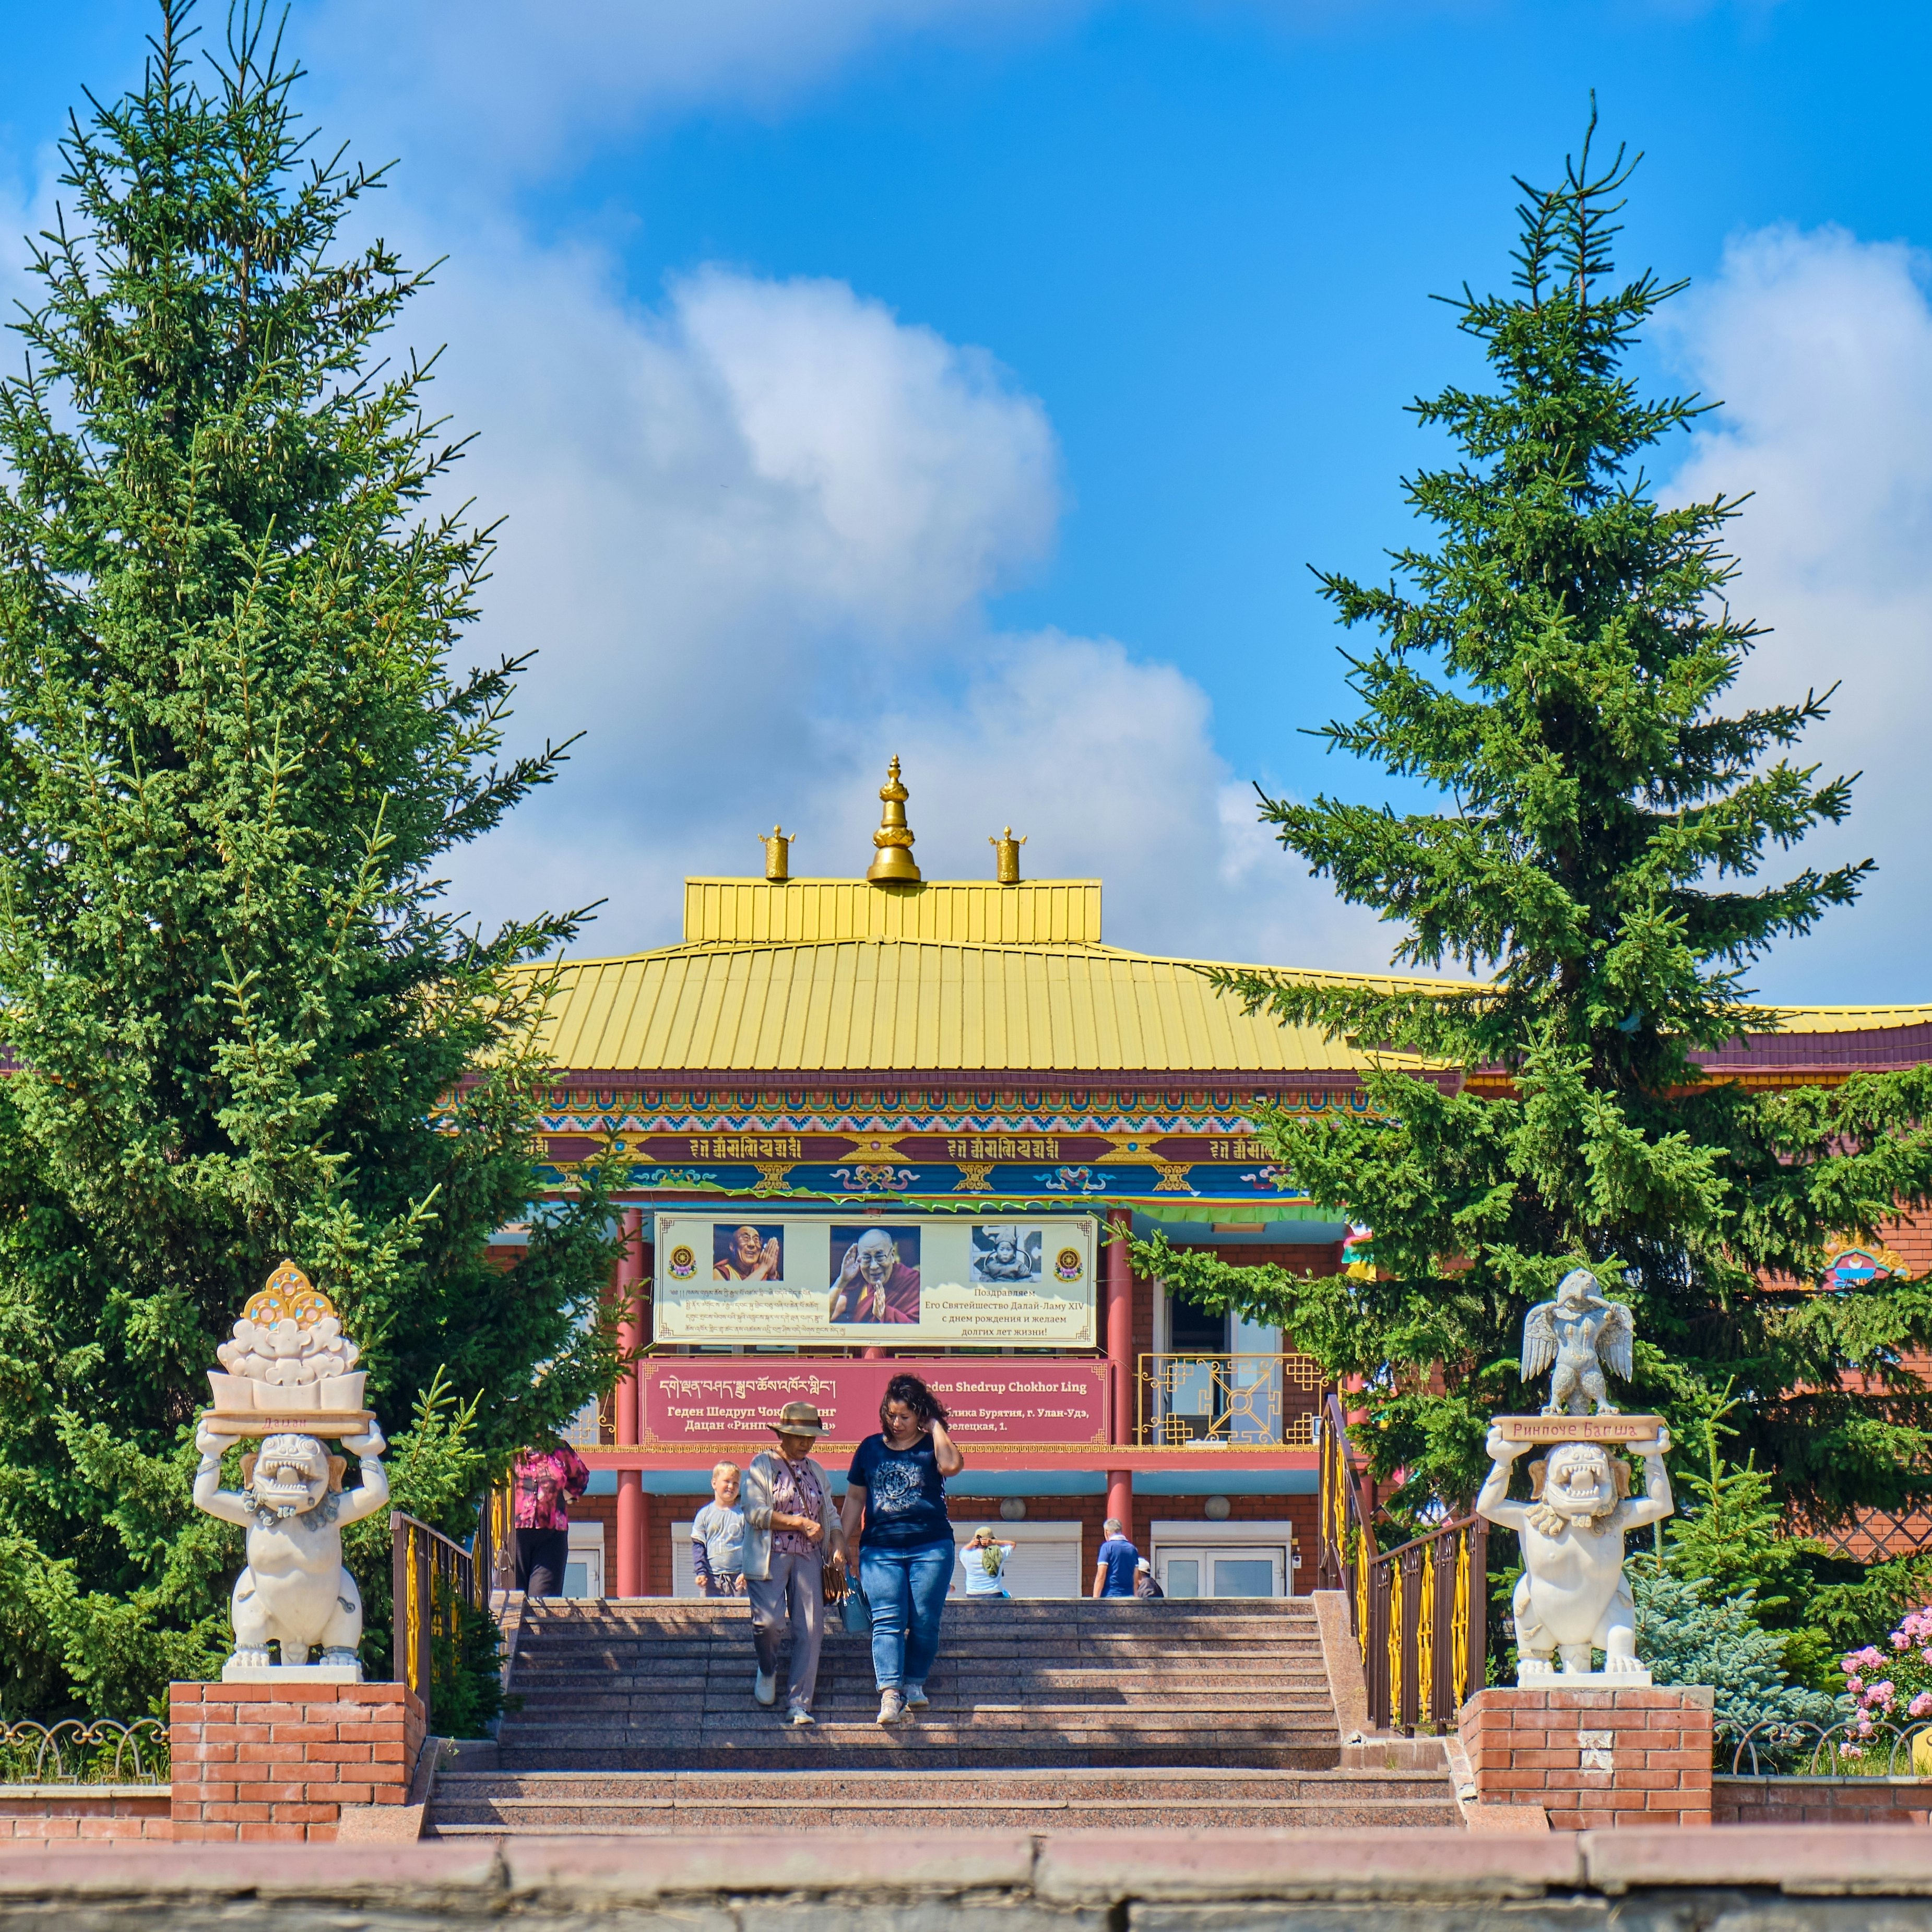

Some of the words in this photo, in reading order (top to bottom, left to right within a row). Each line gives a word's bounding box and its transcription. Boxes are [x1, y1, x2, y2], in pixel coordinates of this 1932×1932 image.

[975, 1288, 1035, 1298] Поздравляем
[942, 1301, 1009, 1309] Святейшество
[1011, 1302, 1066, 1311] Далай-Ламу
[975, 1316, 1021, 1324] рождения
[1014, 1328, 1047, 1336] жизни!
[926, 1382, 954, 1392] eden
[956, 1381, 1006, 1394] Shedrup
[1009, 1381, 1059, 1392] Chokhor
[1061, 1381, 1087, 1395] Ling
[667, 1407, 704, 1418] Геден
[706, 1407, 755, 1419] Шедруп
[979, 1409, 1025, 1419] Бурятия,
[1037, 1409, 1089, 1419] Улан-Удэ,
[262, 1417, 306, 1430] Дацан
[685, 1420, 725, 1432] Дацан
[1514, 1424, 1577, 1437] Ринпоче
